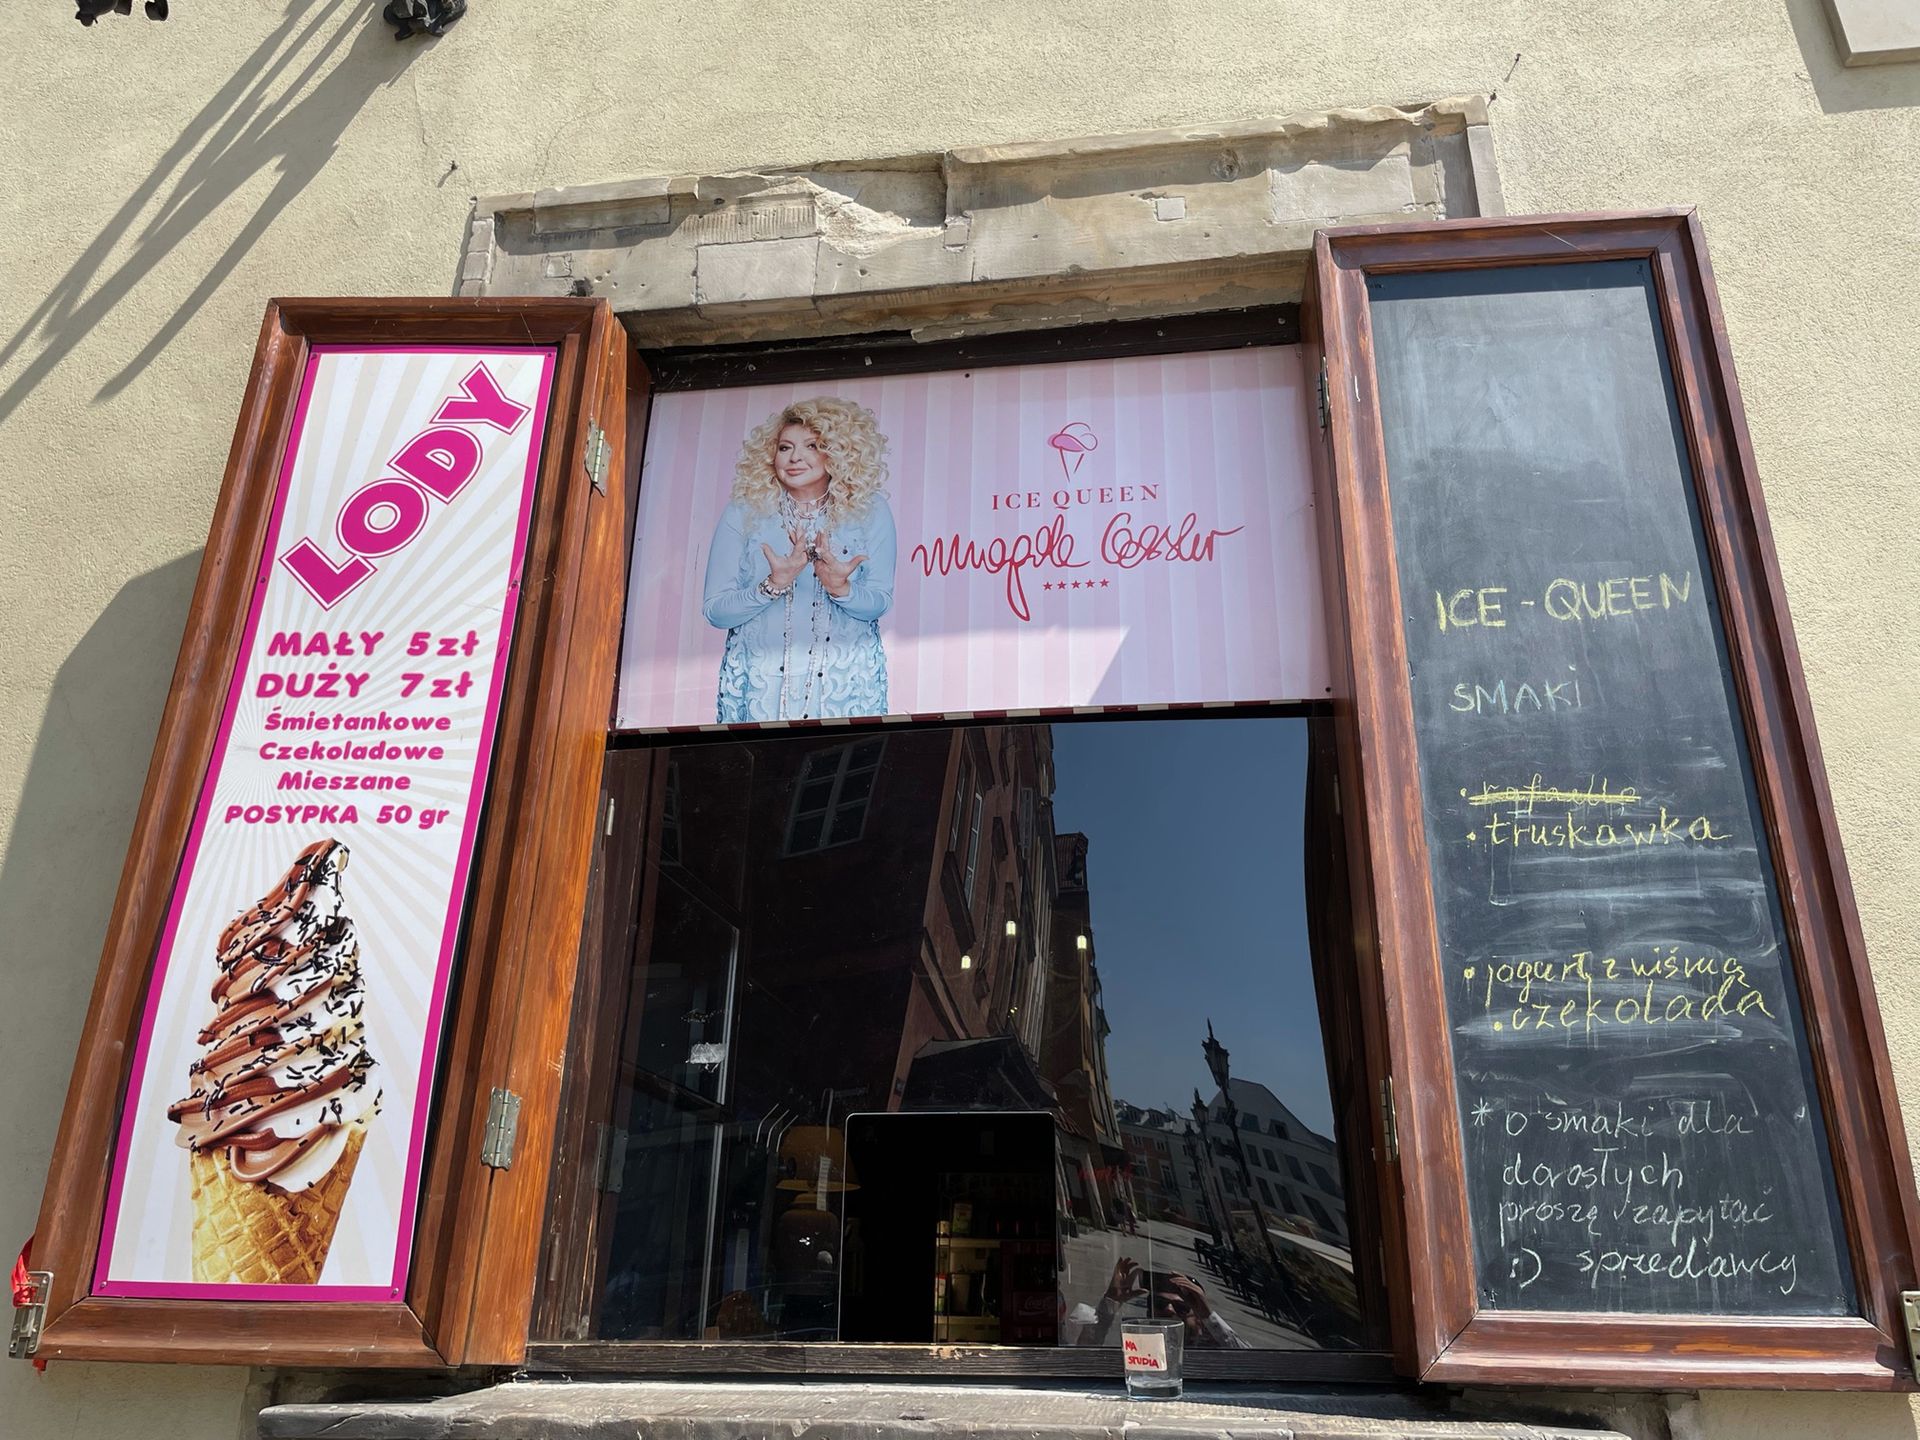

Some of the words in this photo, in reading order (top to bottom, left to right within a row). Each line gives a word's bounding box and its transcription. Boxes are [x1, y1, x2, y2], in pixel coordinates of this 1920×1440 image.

[278, 360, 531, 611] LODY
[992, 491, 1041, 511] ICE
[1052, 484, 1160, 510] QUEEN
[1435, 587, 1508, 634] ICE
[1544, 570, 1691, 623] QUEEN
[267, 631, 385, 657] MAŁY
[256, 661, 370, 698] DUŻY
[264, 706, 452, 731] Śmietankowe
[259, 740, 445, 761] Czekoladowe
[277, 769, 412, 790] Mieszane
[224, 804, 359, 824] POSYPKA
[376, 804, 413, 824] 50
[418, 808, 450, 830] gr
[1485, 805, 1733, 849] truskawka
[1511, 975, 1776, 1032] czekolada
[1678, 1100, 1754, 1135] dla
[1499, 1201, 1602, 1247] proszę
[1575, 1236, 1797, 1294] sprzedawcy
[1125, 1340, 1138, 1352] NA
